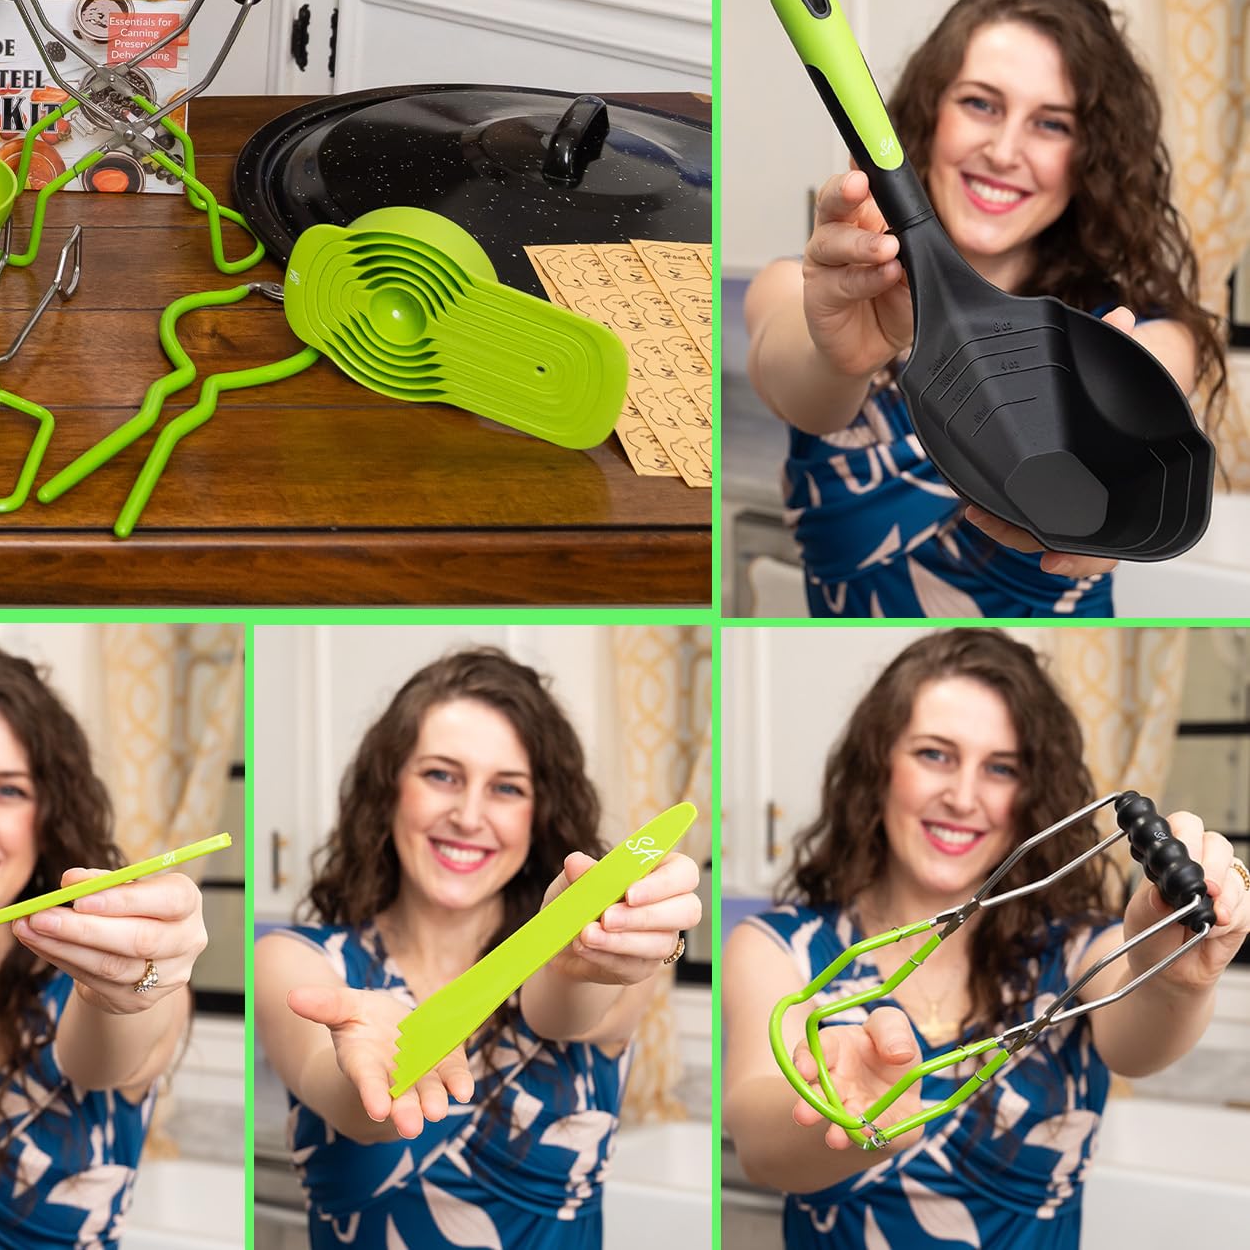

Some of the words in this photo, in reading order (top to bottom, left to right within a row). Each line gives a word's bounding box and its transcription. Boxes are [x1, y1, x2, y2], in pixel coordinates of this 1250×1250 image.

[109, 16, 156, 27] Essentials
[158, 17, 173, 27] for
[120, 28, 160, 40] Canning
[625, 835, 664, 866] SA
